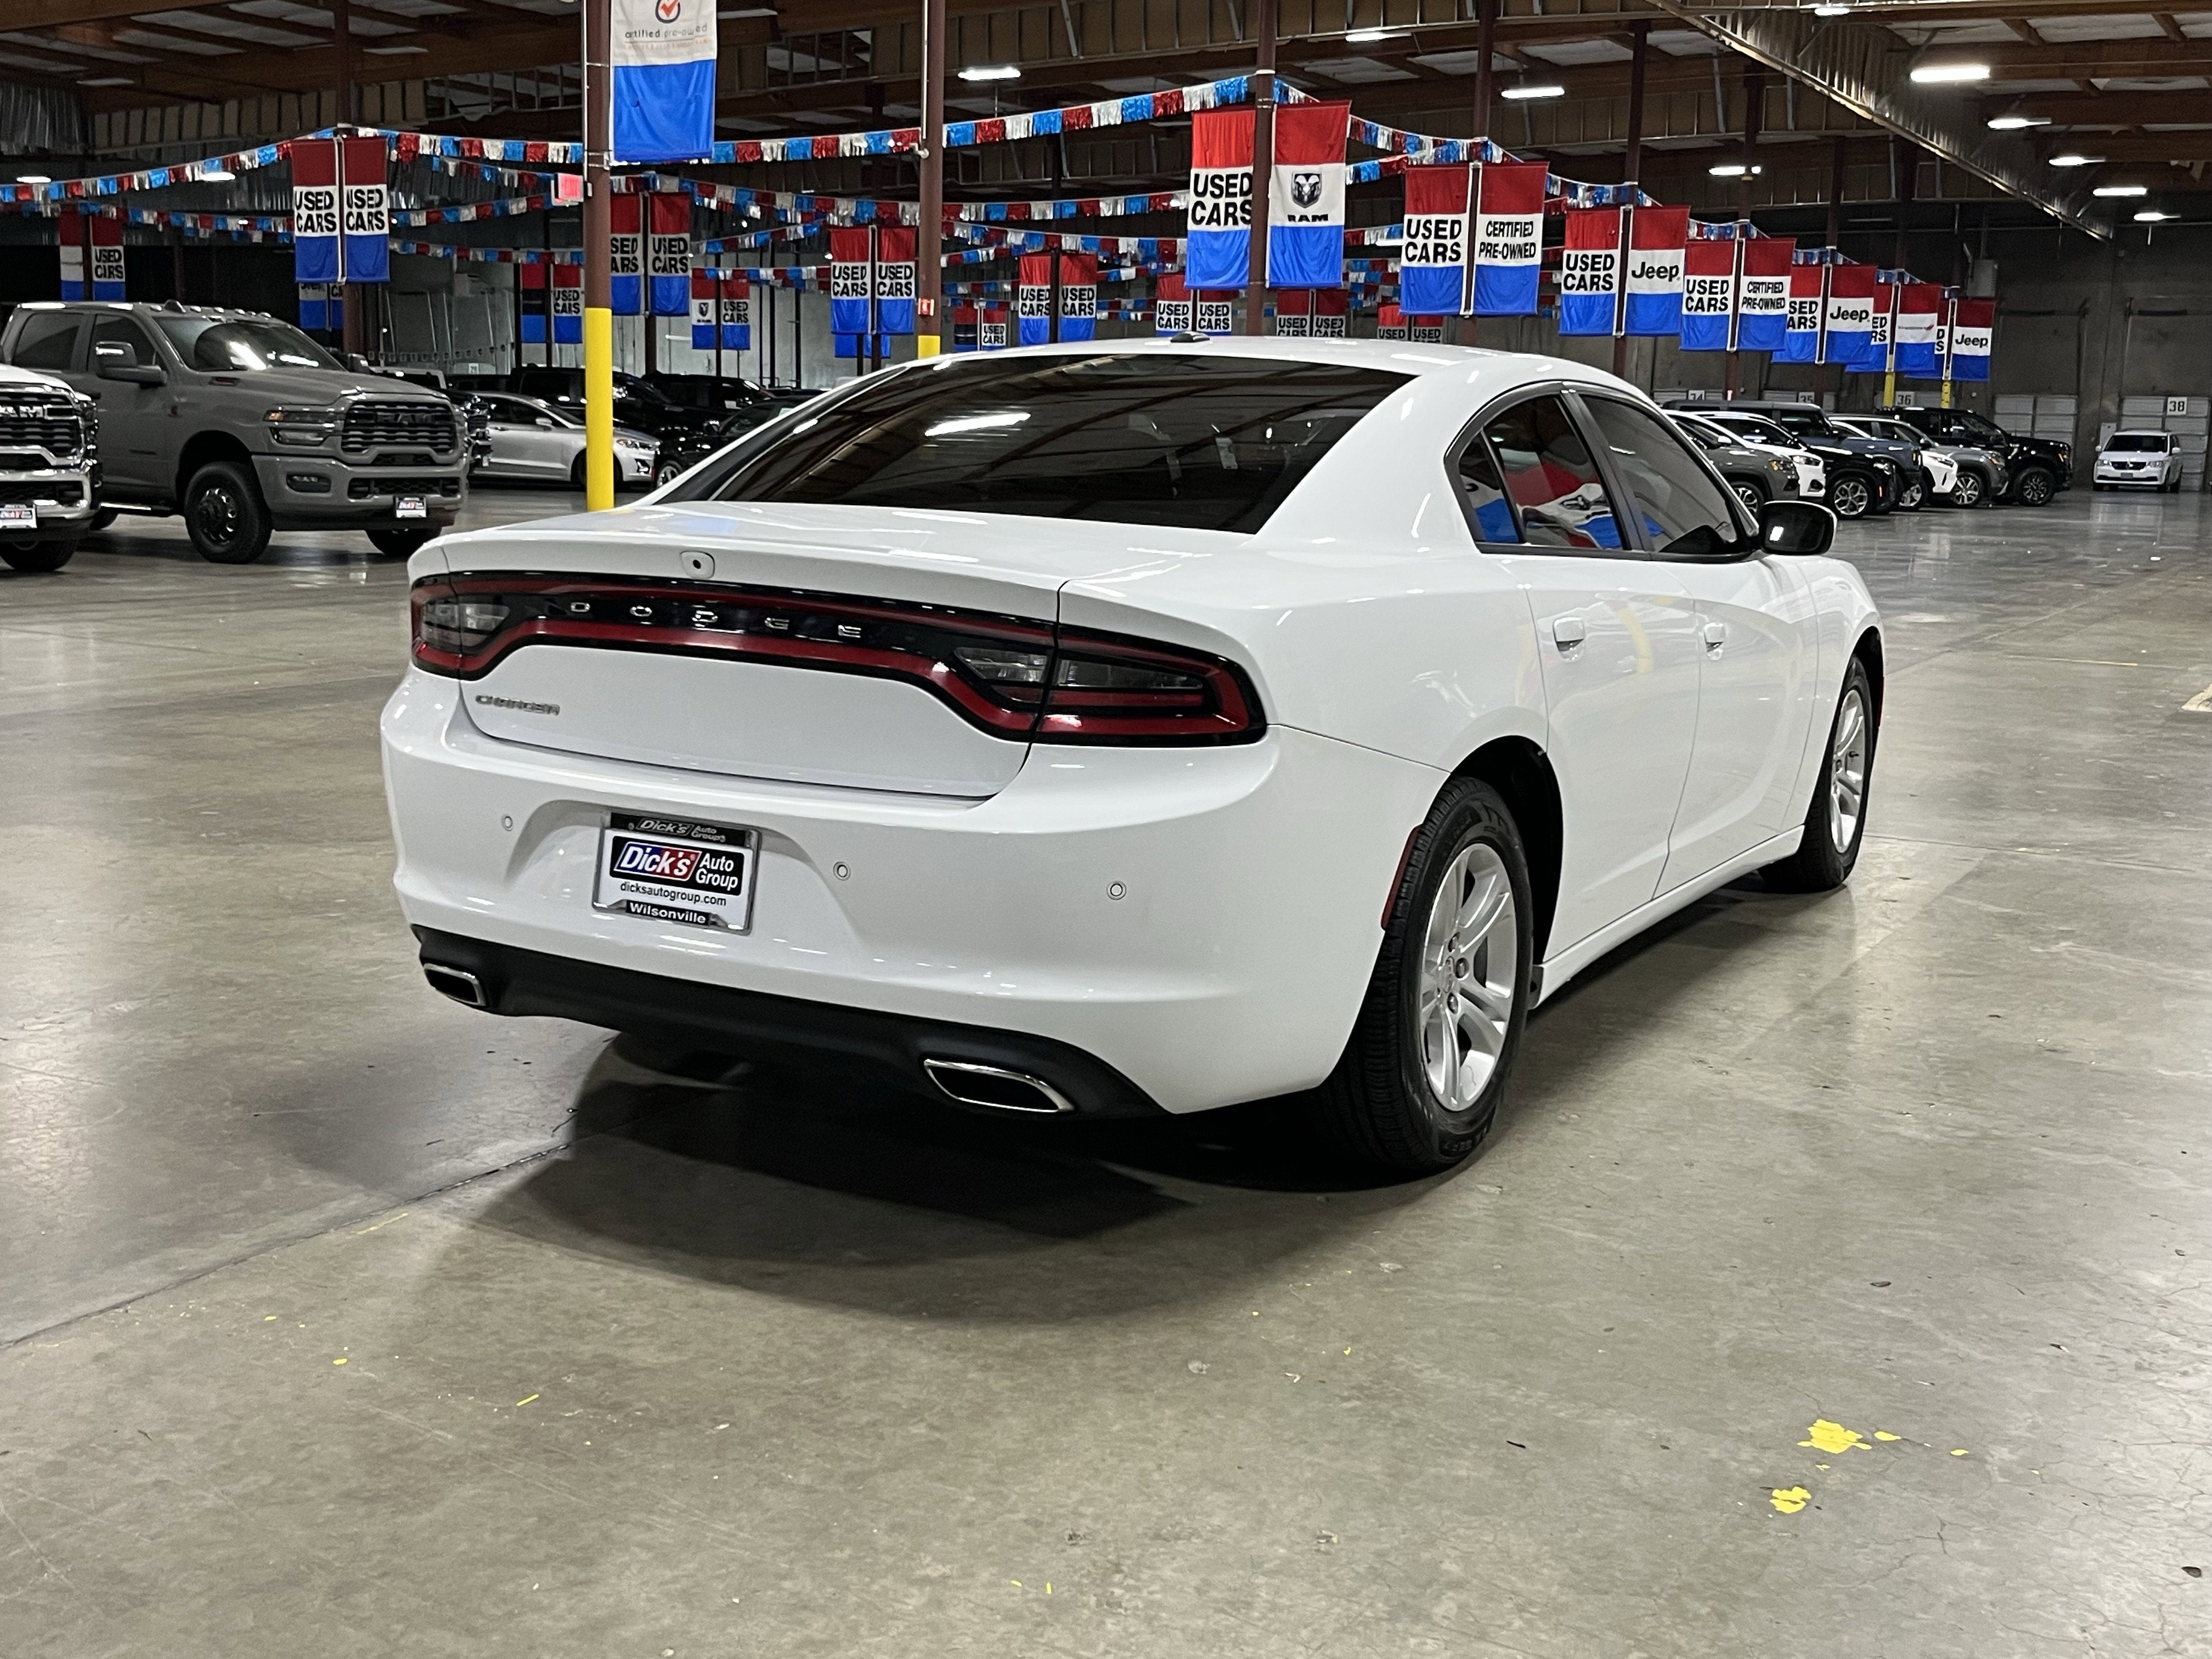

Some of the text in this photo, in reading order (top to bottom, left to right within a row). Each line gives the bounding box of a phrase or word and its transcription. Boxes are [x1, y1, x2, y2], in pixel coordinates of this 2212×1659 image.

[1193, 172, 1253, 199] USED
[295, 191, 335, 211] USED
[346, 189, 383, 209] USED
[1191, 200, 1251, 226] CARS
[1288, 214, 1328, 222] RAM
[296, 212, 337, 233] CARS
[346, 211, 385, 231] CARS
[1406, 219, 1462, 240] USED
[1486, 221, 1533, 238] CERTIFIED
[610, 237, 637, 255] SED
[652, 237, 688, 255] USED
[1405, 241, 1461, 263] CARS
[1479, 242, 1536, 259] PRE-OWNED
[94, 248, 122, 263] USED
[1566, 253, 1615, 272] USED
[611, 256, 639, 273] ARS
[652, 256, 688, 273] CARS
[878, 264, 913, 280] USED
[1632, 262, 1680, 282] Jeep
[833, 265, 867, 280] USED
[833, 281, 868, 296] CARS
[877, 281, 912, 296] CARS
[1564, 273, 1613, 291] CARS
[1686, 279, 1729, 295] USED
[1747, 281, 1784, 294] CERTIFIED
[553, 290, 580, 301] USED
[1021, 288, 1050, 301] USED
[1062, 288, 1094, 301] USED
[724, 301, 748, 312] USED
[1020, 303, 1050, 316] CARS
[1062, 302, 1094, 316] CARS
[1158, 303, 1189, 316] USED
[1199, 304, 1229, 317] USED
[1685, 296, 1728, 312] CARS
[1788, 301, 1818, 314] SED
[723, 313, 749, 323] CARS
[1830, 306, 1870, 323] Jeep
[984, 325, 1005, 334] USED
[1158, 317, 1189, 329] CARS
[1198, 318, 1230, 330] CARS
[1278, 317, 1307, 329] USED
[1316, 317, 1344, 329] USED
[1787, 316, 1817, 329] ARS
[983, 335, 1004, 344] CARS
[1379, 329, 1406, 339] USED
[1414, 329, 1441, 339] USED
[1955, 334, 1988, 348] Jeep
[1898, 394, 1911, 405] 36
[2169, 401, 2185, 411] 38
[570, 602, 862, 638] DODGE
[640, 820, 717, 834] Dick's Auto
[620, 847, 734, 876] Dick's Auto
[696, 870, 738, 891] Group
[620, 882, 726, 906] dicksautogroup.com
[629, 902, 706, 924] Wilsonville
